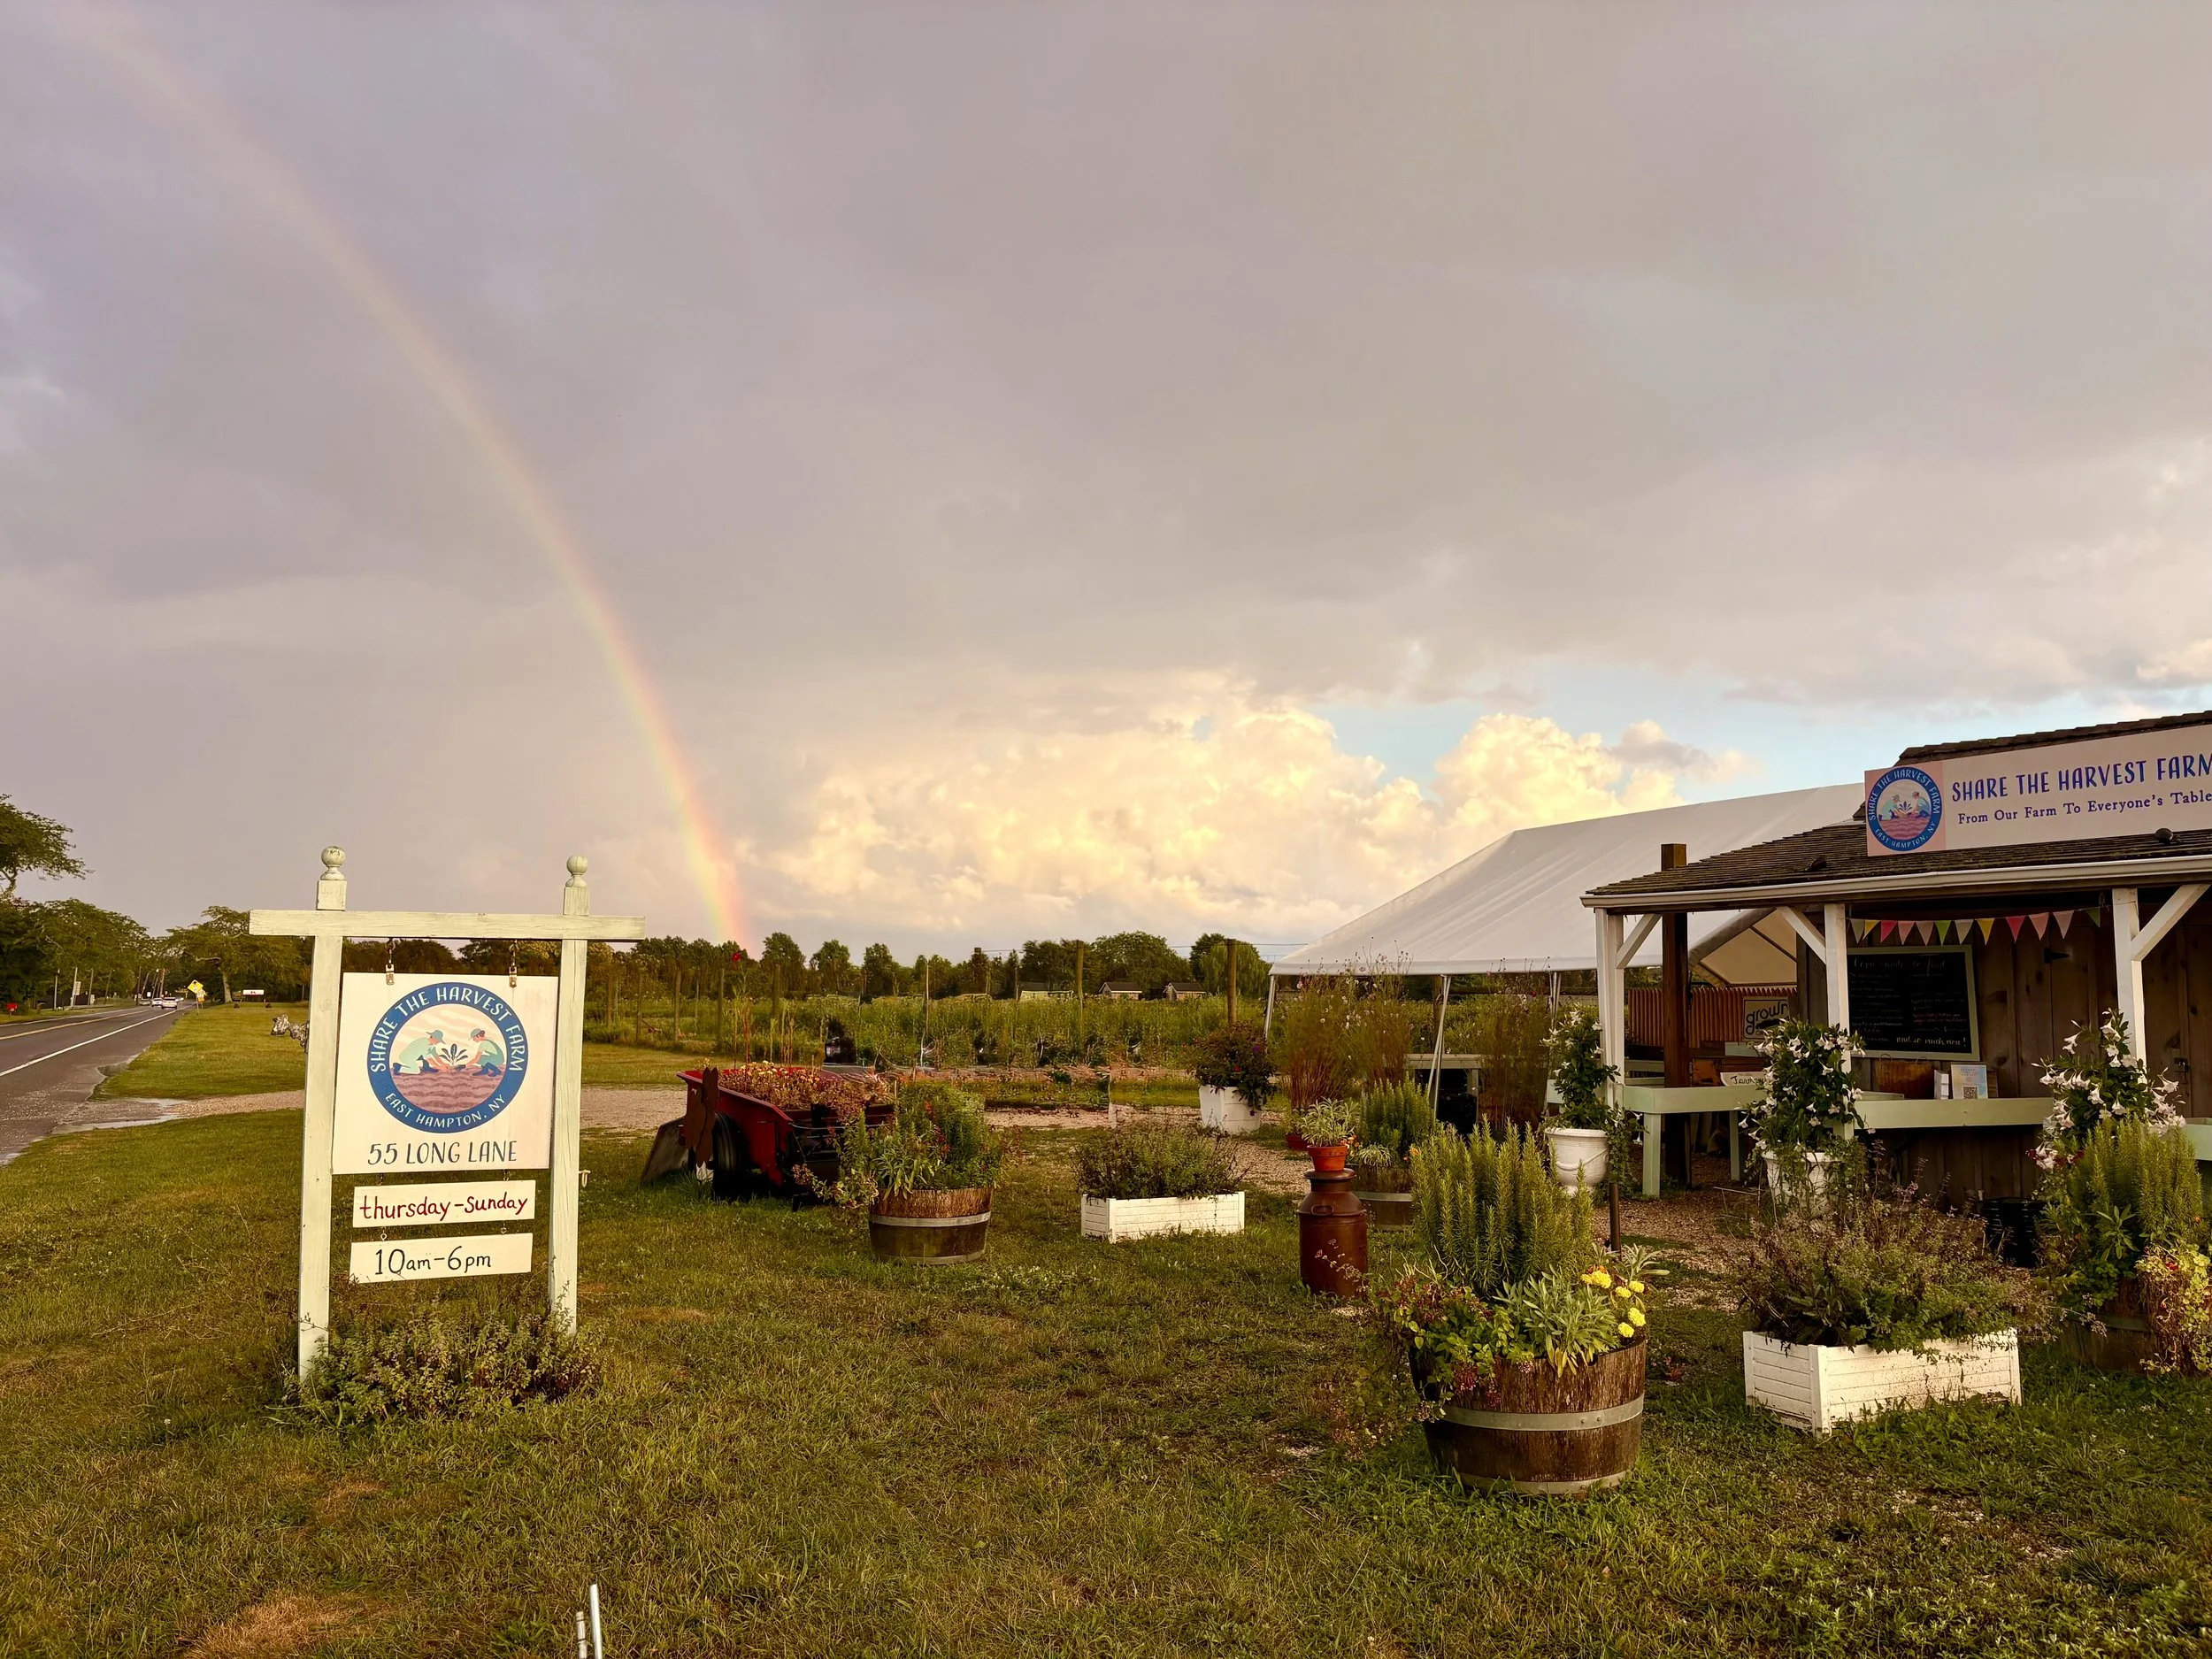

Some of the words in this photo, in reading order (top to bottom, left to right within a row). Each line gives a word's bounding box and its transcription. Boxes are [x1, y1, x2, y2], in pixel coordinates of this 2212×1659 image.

[1952, 776, 2008, 803] SHARE
[2016, 770, 2050, 795] THE
[2058, 758, 2147, 792] HARVEST
[2156, 753, 2212, 780] FARM
[1868, 791, 1879, 821] SHARE
[1876, 774, 1892, 789] THE
[1893, 769, 1932, 787] HARVEST
[1929, 787, 1940, 814] FARM
[1957, 811, 1988, 825] From
[1993, 808, 2018, 821] Our
[2024, 804, 2057, 818] Farm
[2062, 801, 2082, 815] To
[2087, 794, 2163, 813] Everyone's
[2170, 789, 2212, 805] Table
[1875, 828, 1890, 843] EAST
[1927, 822, 1937, 833] NY
[370, 1017, 397, 1072] SHARE
[395, 991, 430, 1017] THE
[436, 987, 512, 1021] HARVEST
[505, 1024, 525, 1072] FARM
[385, 1093, 413, 1118] EAST
[488, 1094, 507, 1115] NY
[367, 1142, 398, 1165] 55
[405, 1141, 461, 1164] LONG
[468, 1140, 518, 1163] LANE
[374, 1245, 492, 1275] 10am-6pm
